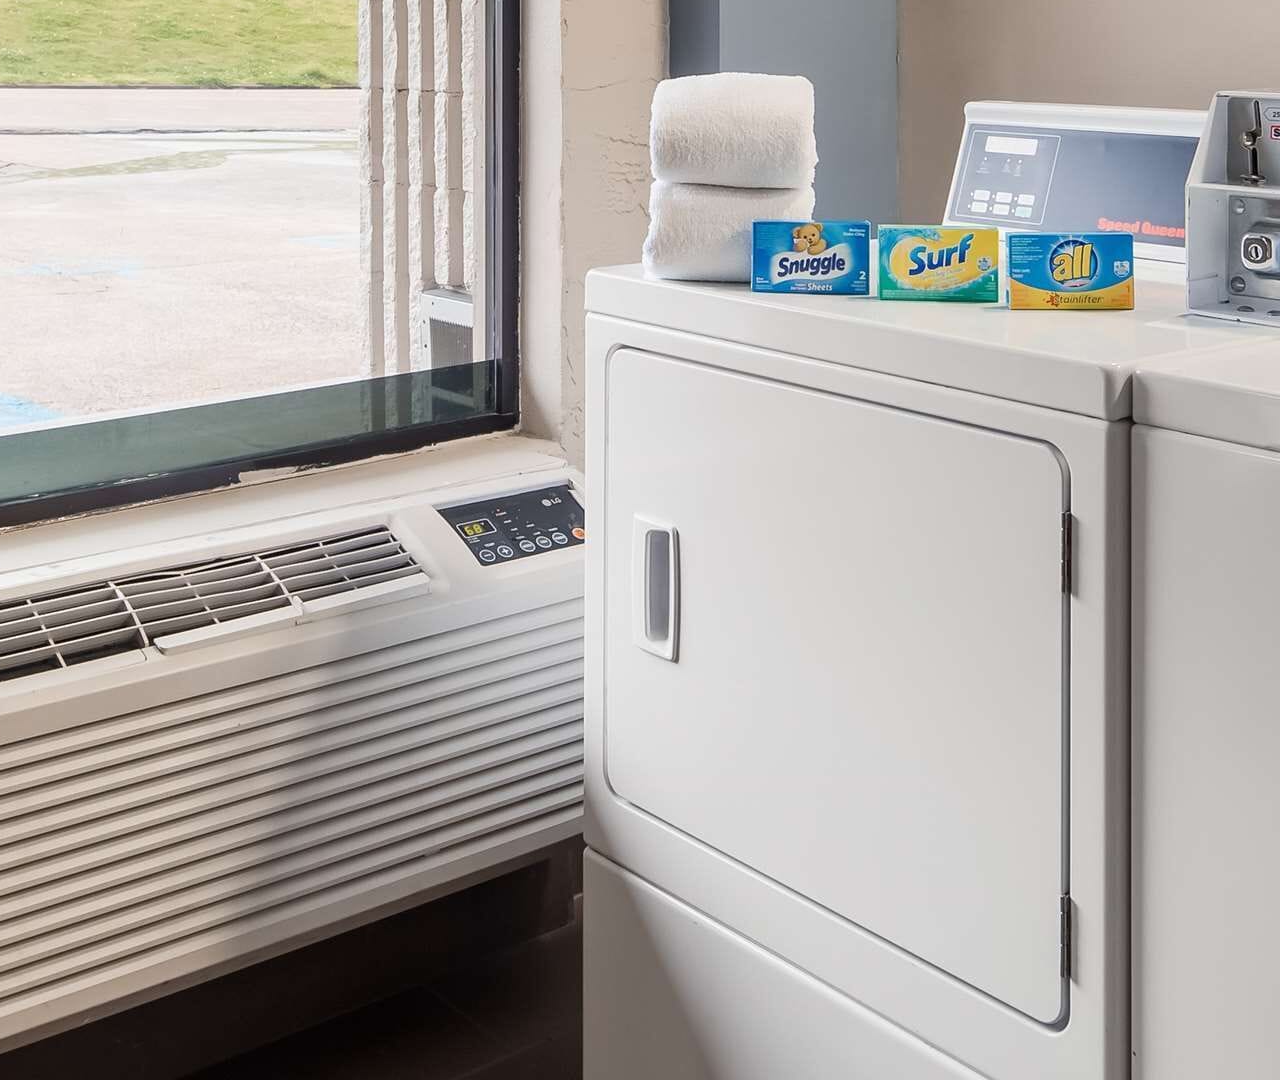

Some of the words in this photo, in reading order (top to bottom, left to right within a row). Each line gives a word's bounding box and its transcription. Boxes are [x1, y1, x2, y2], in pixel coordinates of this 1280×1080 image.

[1096, 216, 1140, 234] Speed
[777, 252, 846, 278] Snuggle
[908, 233, 975, 276] Surf
[1051, 242, 1094, 282] all
[858, 271, 867, 280] 2
[807, 282, 833, 292] Sheets
